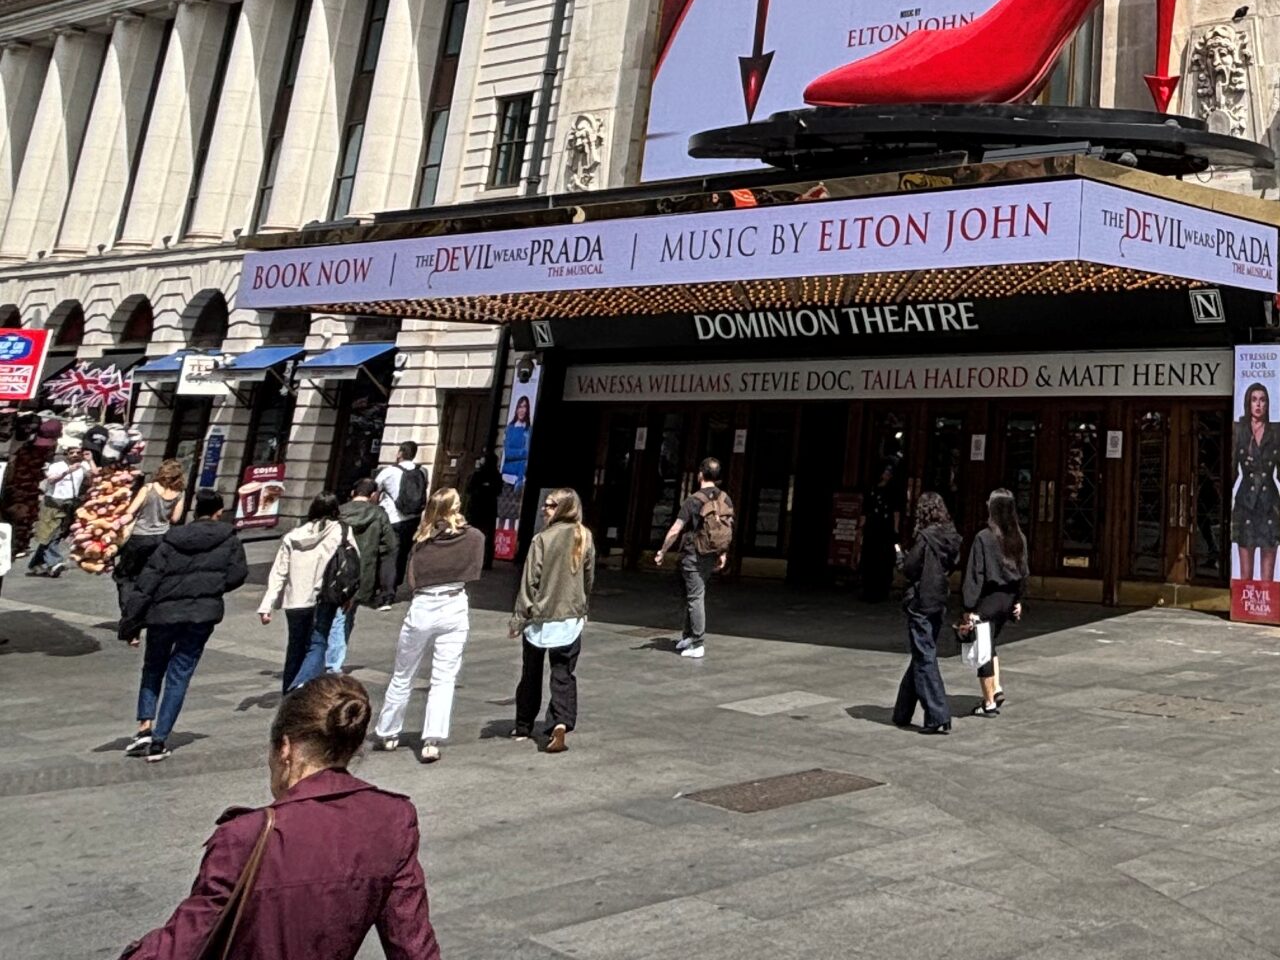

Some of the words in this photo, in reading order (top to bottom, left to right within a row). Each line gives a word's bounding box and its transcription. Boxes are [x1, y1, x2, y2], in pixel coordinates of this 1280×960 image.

[847, 22, 910, 48] ELTON
[660, 225, 758, 263] MUSIC
[771, 222, 807, 255] BY
[818, 212, 930, 252] ELTON
[944, 202, 1052, 253] JOHN
[1101, 209, 1124, 229] THE
[1124, 207, 1185, 249] DEVIL
[1184, 229, 1216, 248] WEARS
[1216, 228, 1272, 267] PRADA
[416, 254, 435, 269] THE
[434, 244, 494, 273] DEVIL
[493, 247, 528, 263] WEARS
[528, 235, 604, 266] PRADA
[253, 261, 311, 290] BOOK
[317, 257, 373, 286] NOW
[548, 266, 564, 278] THE
[566, 263, 604, 276] MUSICAL
[1232, 262, 1245, 274] THE
[1246, 264, 1273, 280] MUSICAL
[694, 308, 840, 340] DOMINION
[842, 302, 979, 335] THEATRE
[1240, 352, 1278, 361] STRESSED
[1250, 361, 1267, 370] FOR
[577, 375, 643, 394] VANESSA
[649, 372, 734, 394] WILLIAMS,
[739, 370, 800, 392] STEVIE
[805, 370, 854, 392] DOC,
[861, 369, 916, 390] TAILA
[923, 366, 1029, 390] HALFORD
[1036, 365, 1051, 387] &
[1058, 364, 1125, 387] MATT
[1132, 362, 1222, 387] HENRY
[1241, 370, 1276, 378] SUCCESS
[253, 466, 278, 474] COSTA
[1242, 589, 1271, 601] DEVIL
